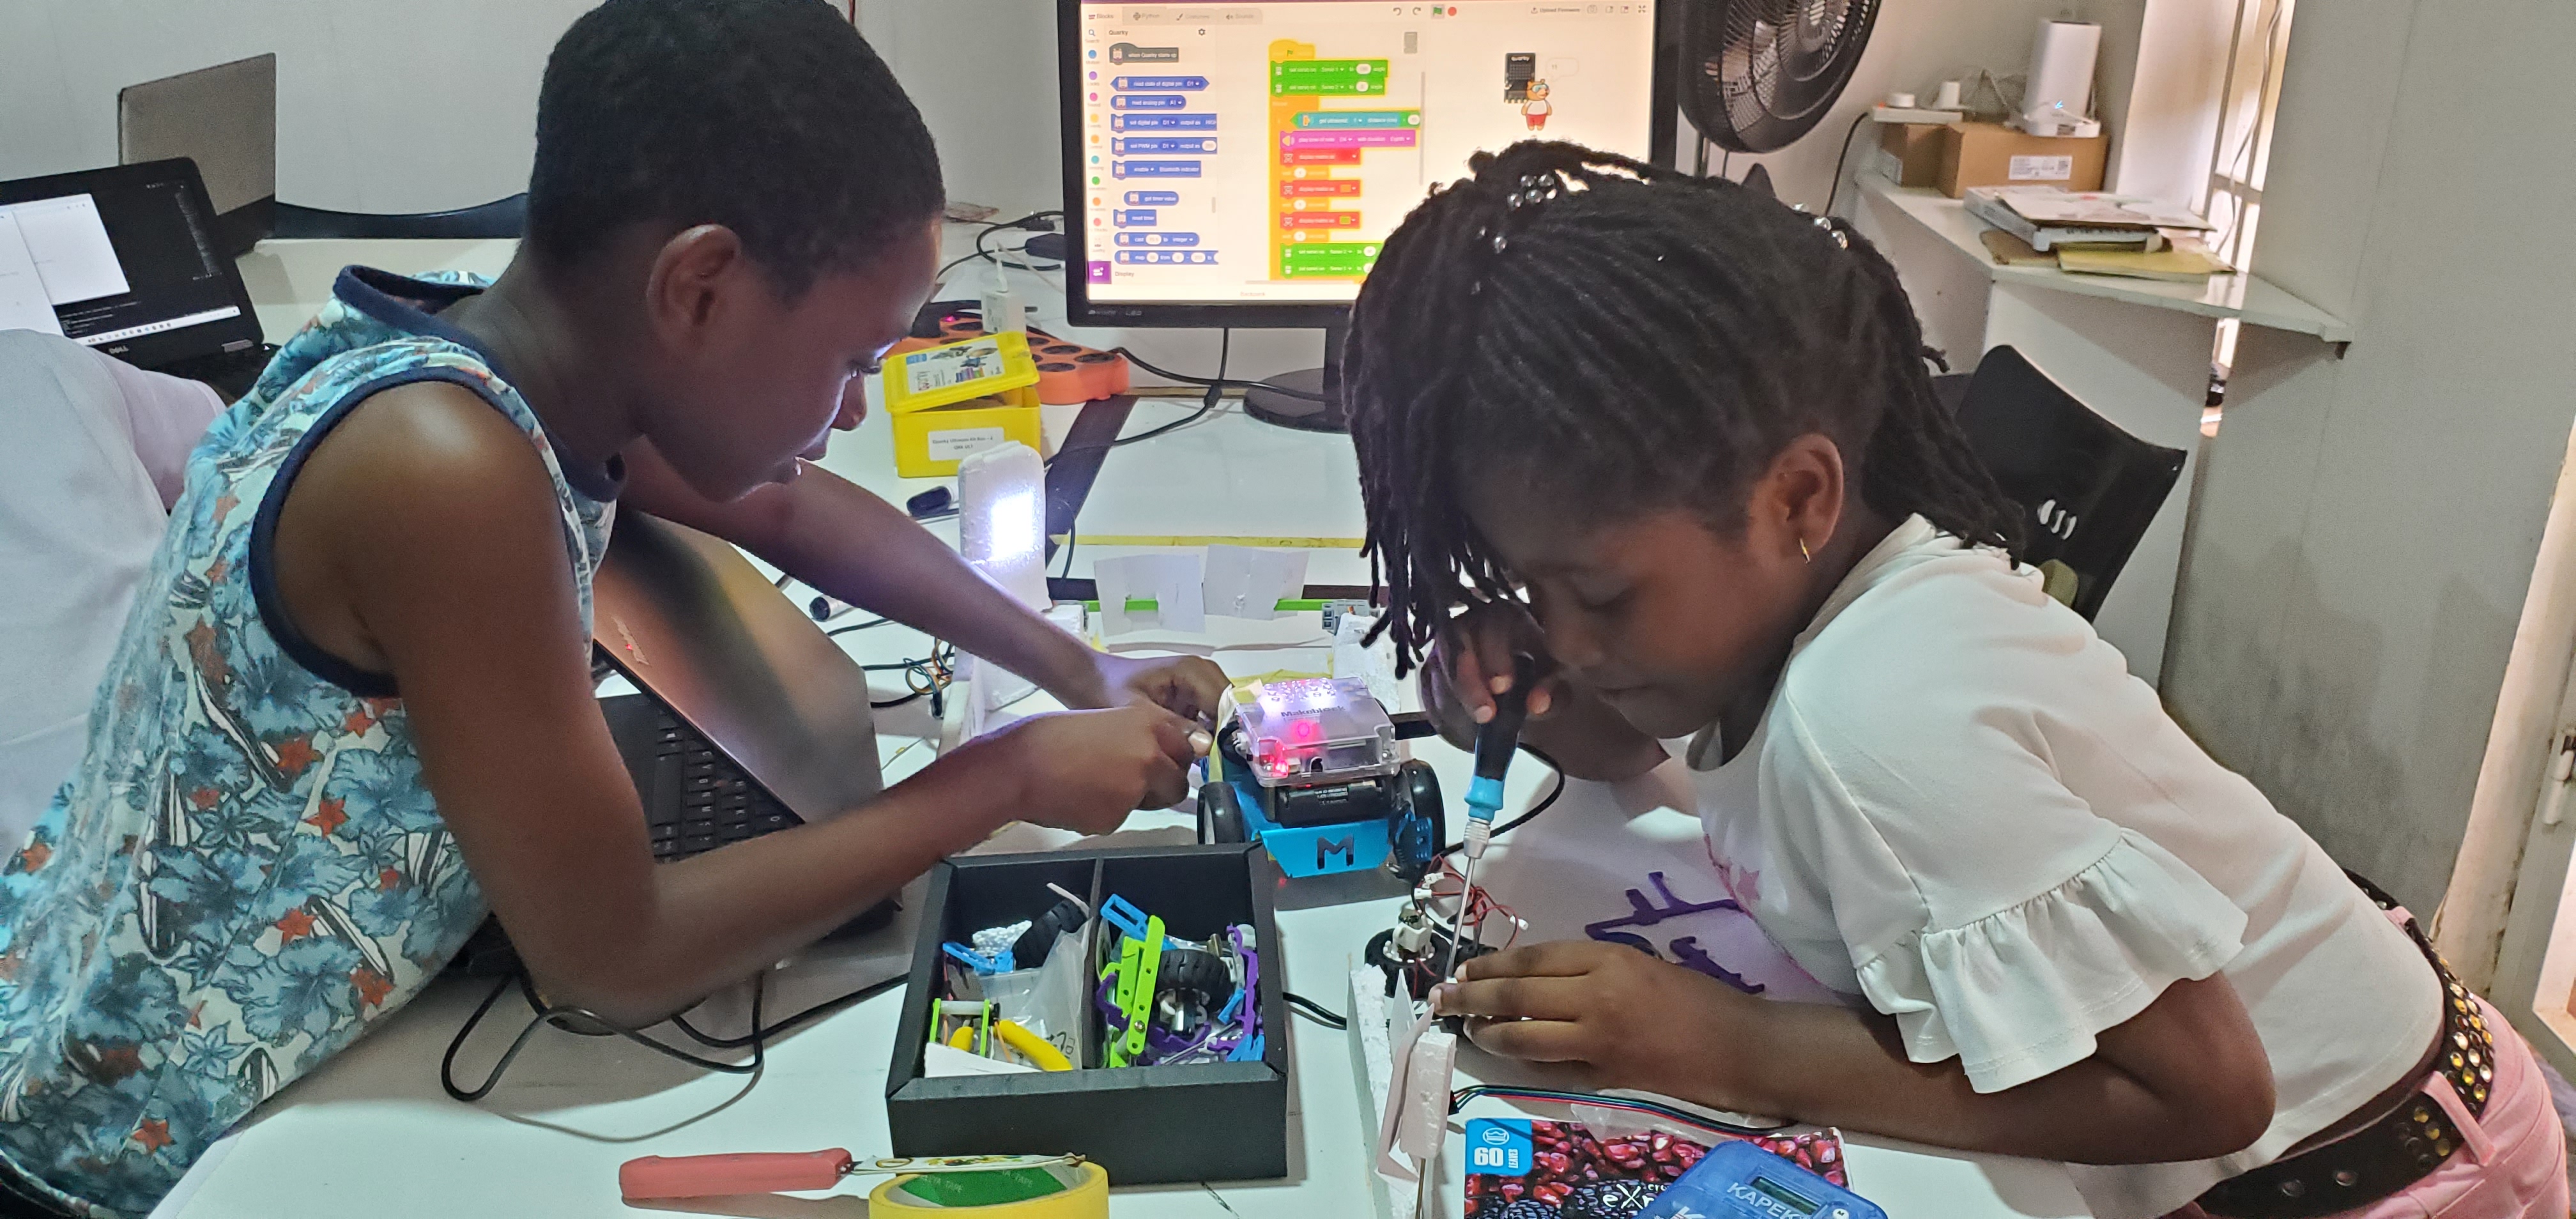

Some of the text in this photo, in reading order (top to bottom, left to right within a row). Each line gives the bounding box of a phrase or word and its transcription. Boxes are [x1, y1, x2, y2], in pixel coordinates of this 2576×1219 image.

[1280, 705, 1346, 717] Makeblock
[1316, 834, 1354, 870] M
[1474, 1147, 1504, 1167] 60
[1508, 1148, 1519, 1169] LEAVES
